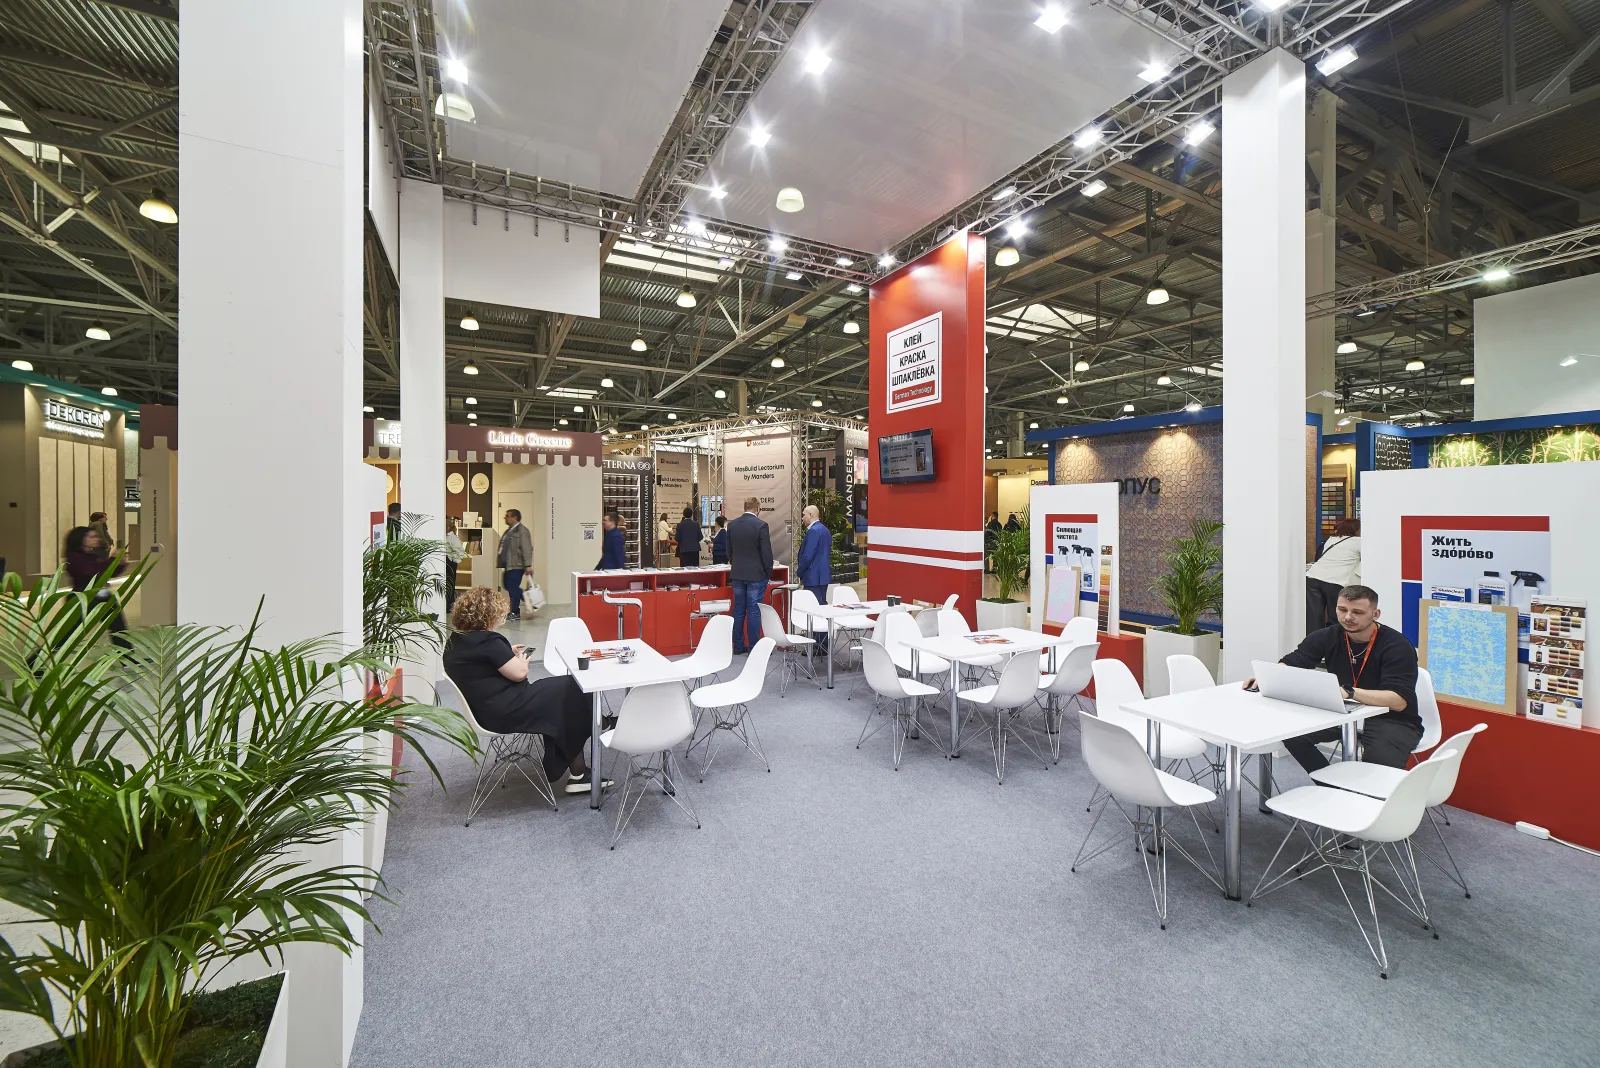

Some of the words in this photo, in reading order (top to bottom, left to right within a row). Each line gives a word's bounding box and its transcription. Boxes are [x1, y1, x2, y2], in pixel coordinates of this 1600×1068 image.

[904, 331, 922, 348] КЛЕЙ
[900, 349, 927, 367] КРАСКА
[892, 364, 935, 386] ШПАКЛЁВКА
[489, 431, 523, 445] Little
[527, 432, 573, 447] Greene
[734, 465, 758, 473] MosBuild
[758, 463, 785, 471] Lectorium
[743, 473, 750, 481] by
[1431, 535, 1472, 547] Жить
